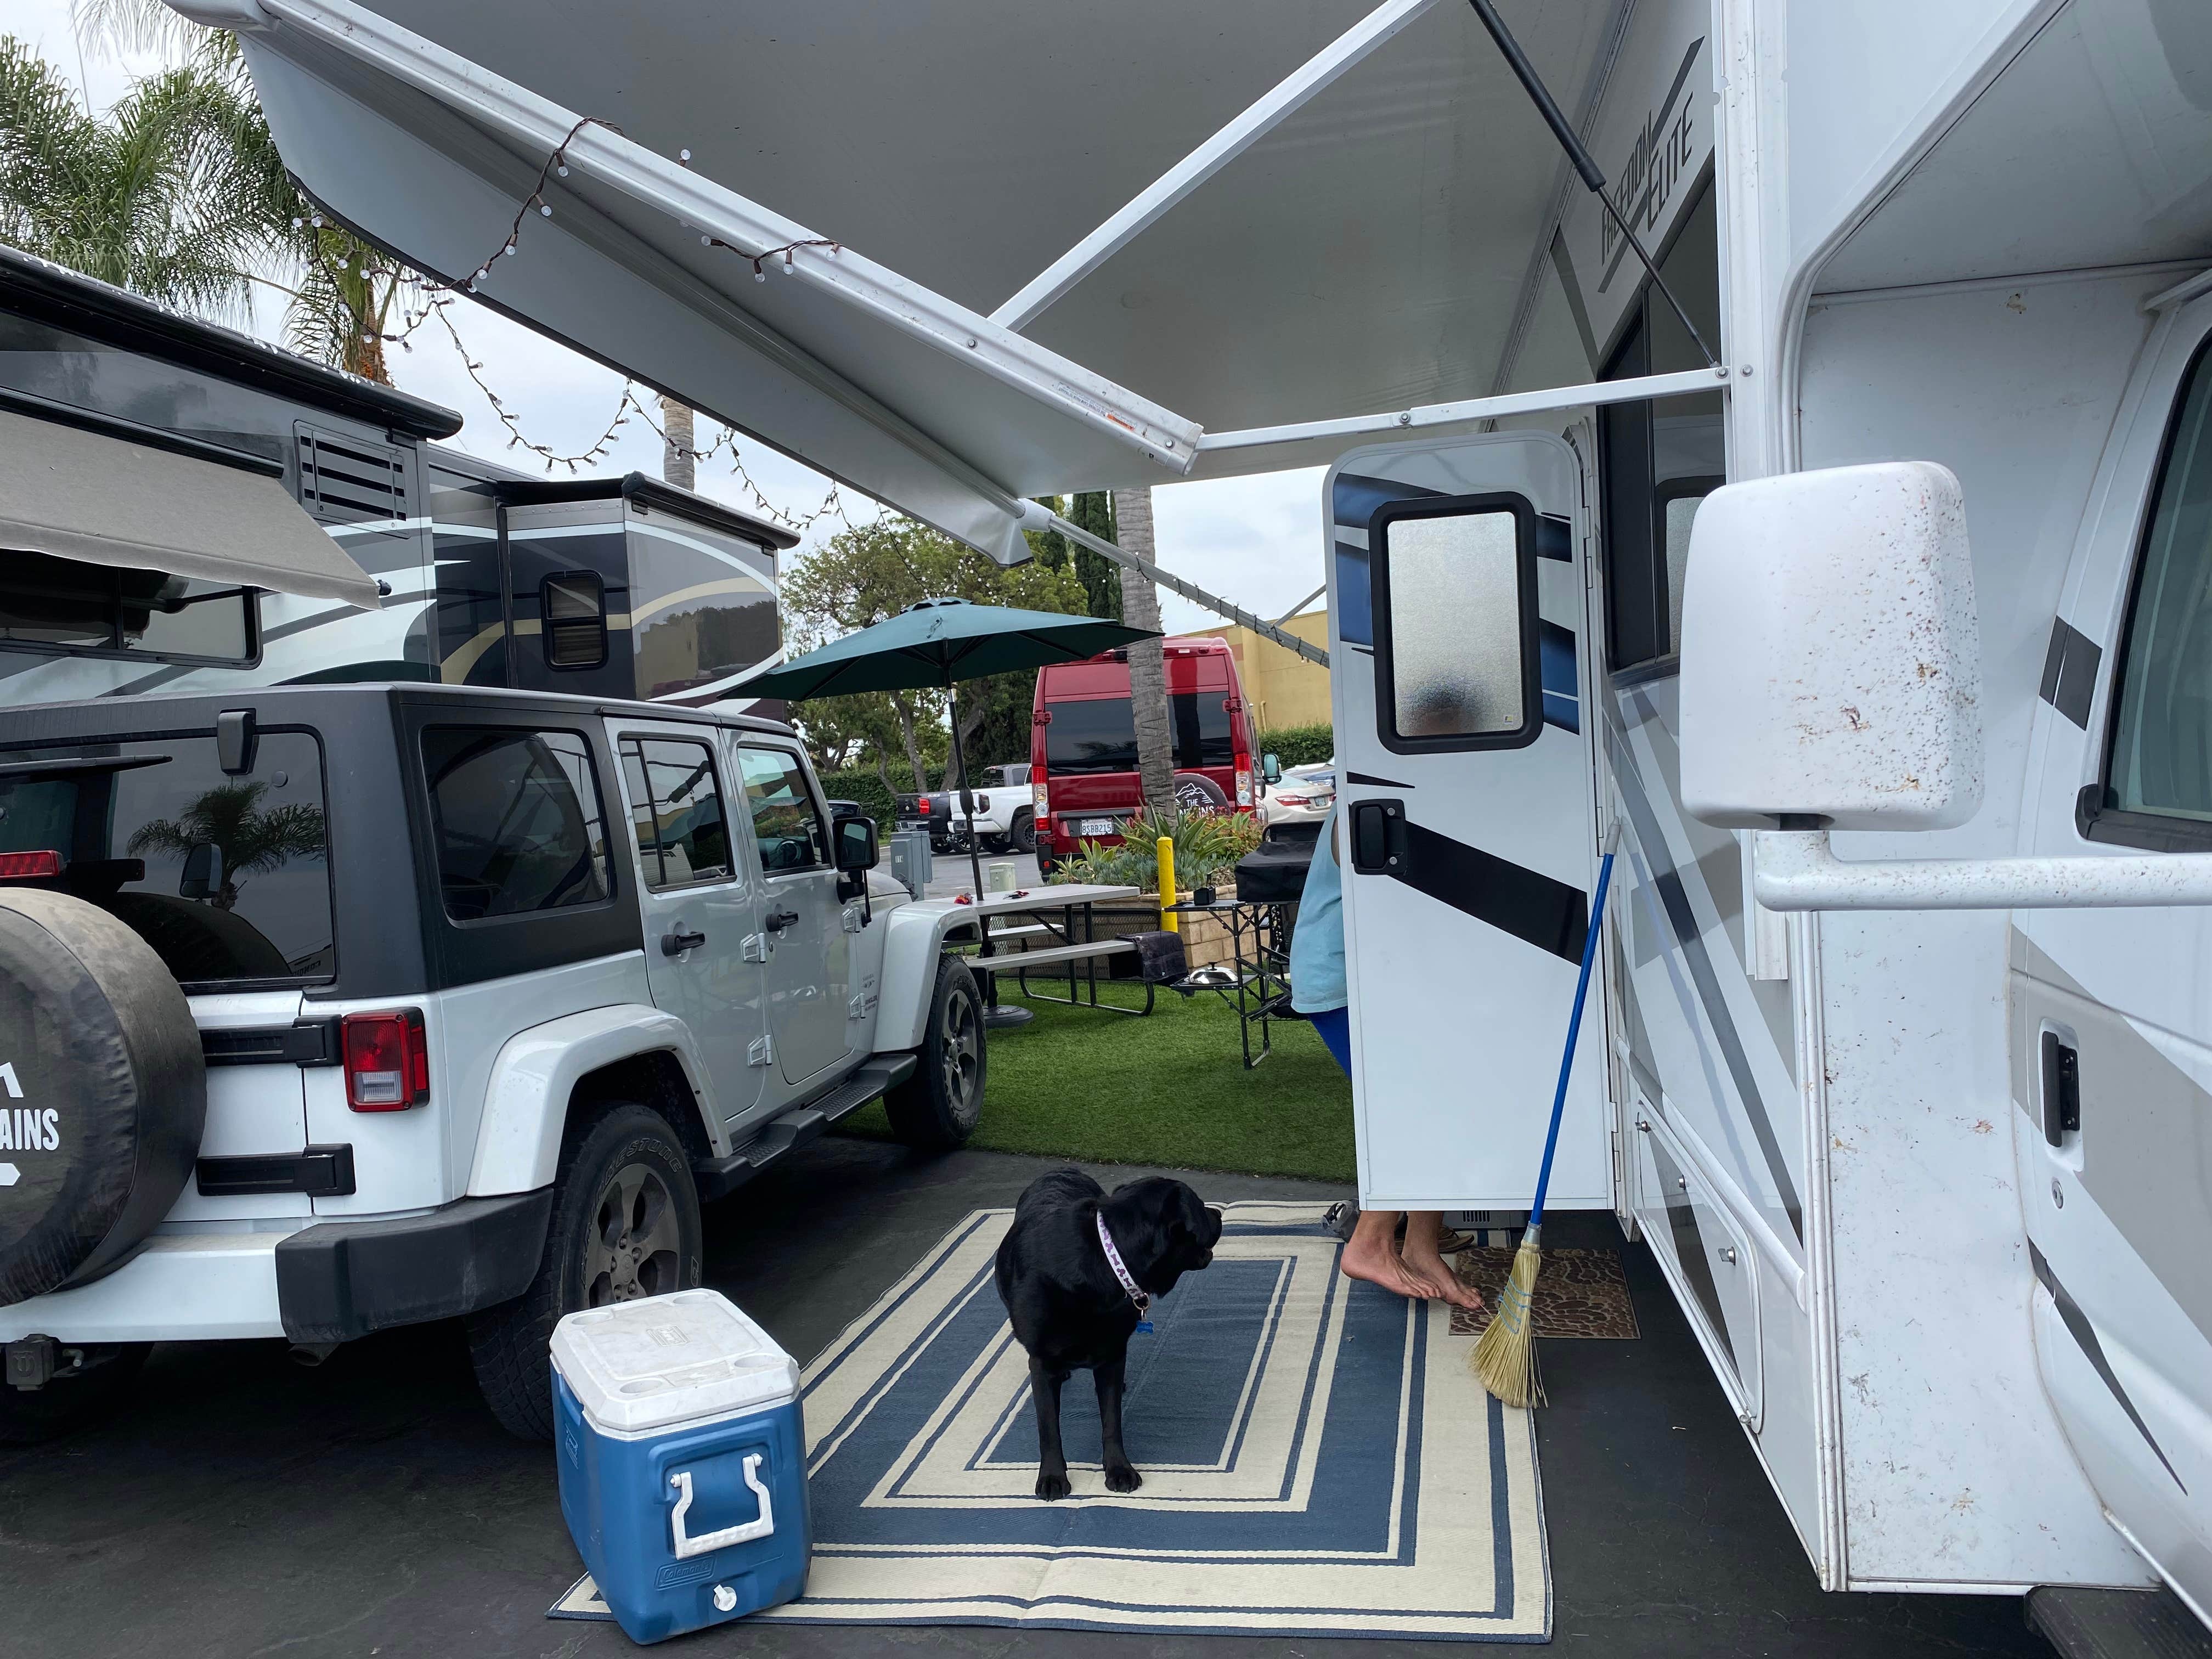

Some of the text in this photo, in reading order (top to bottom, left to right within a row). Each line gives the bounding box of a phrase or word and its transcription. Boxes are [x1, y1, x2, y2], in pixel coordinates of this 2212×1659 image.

[1648, 92, 1692, 233] ELITE
[1186, 799, 1198, 807] THE
[1082, 824, 1111, 833] 8SBB215
[663, 1565, 700, 1580] Coleman
